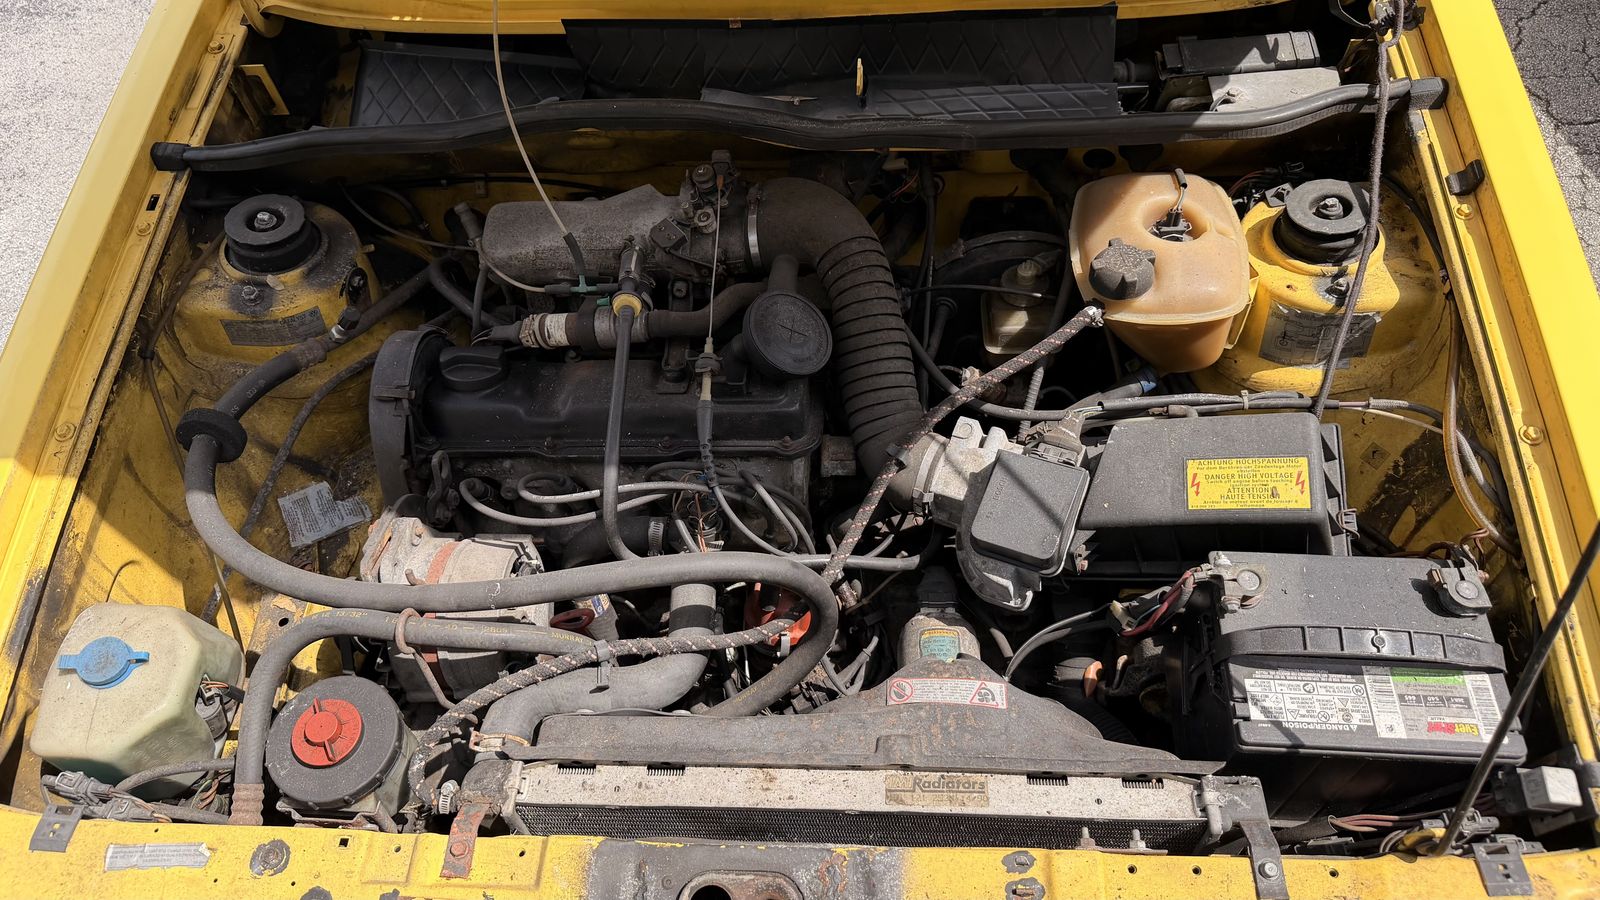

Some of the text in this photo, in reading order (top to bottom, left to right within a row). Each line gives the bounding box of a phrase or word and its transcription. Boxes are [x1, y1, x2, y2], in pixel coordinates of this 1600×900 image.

[551, 631, 585, 644] MURRAY
[1282, 721, 1350, 730] DANGER/POISON
[1427, 721, 1479, 736] EverStart
[913, 775, 986, 791] Radiators
